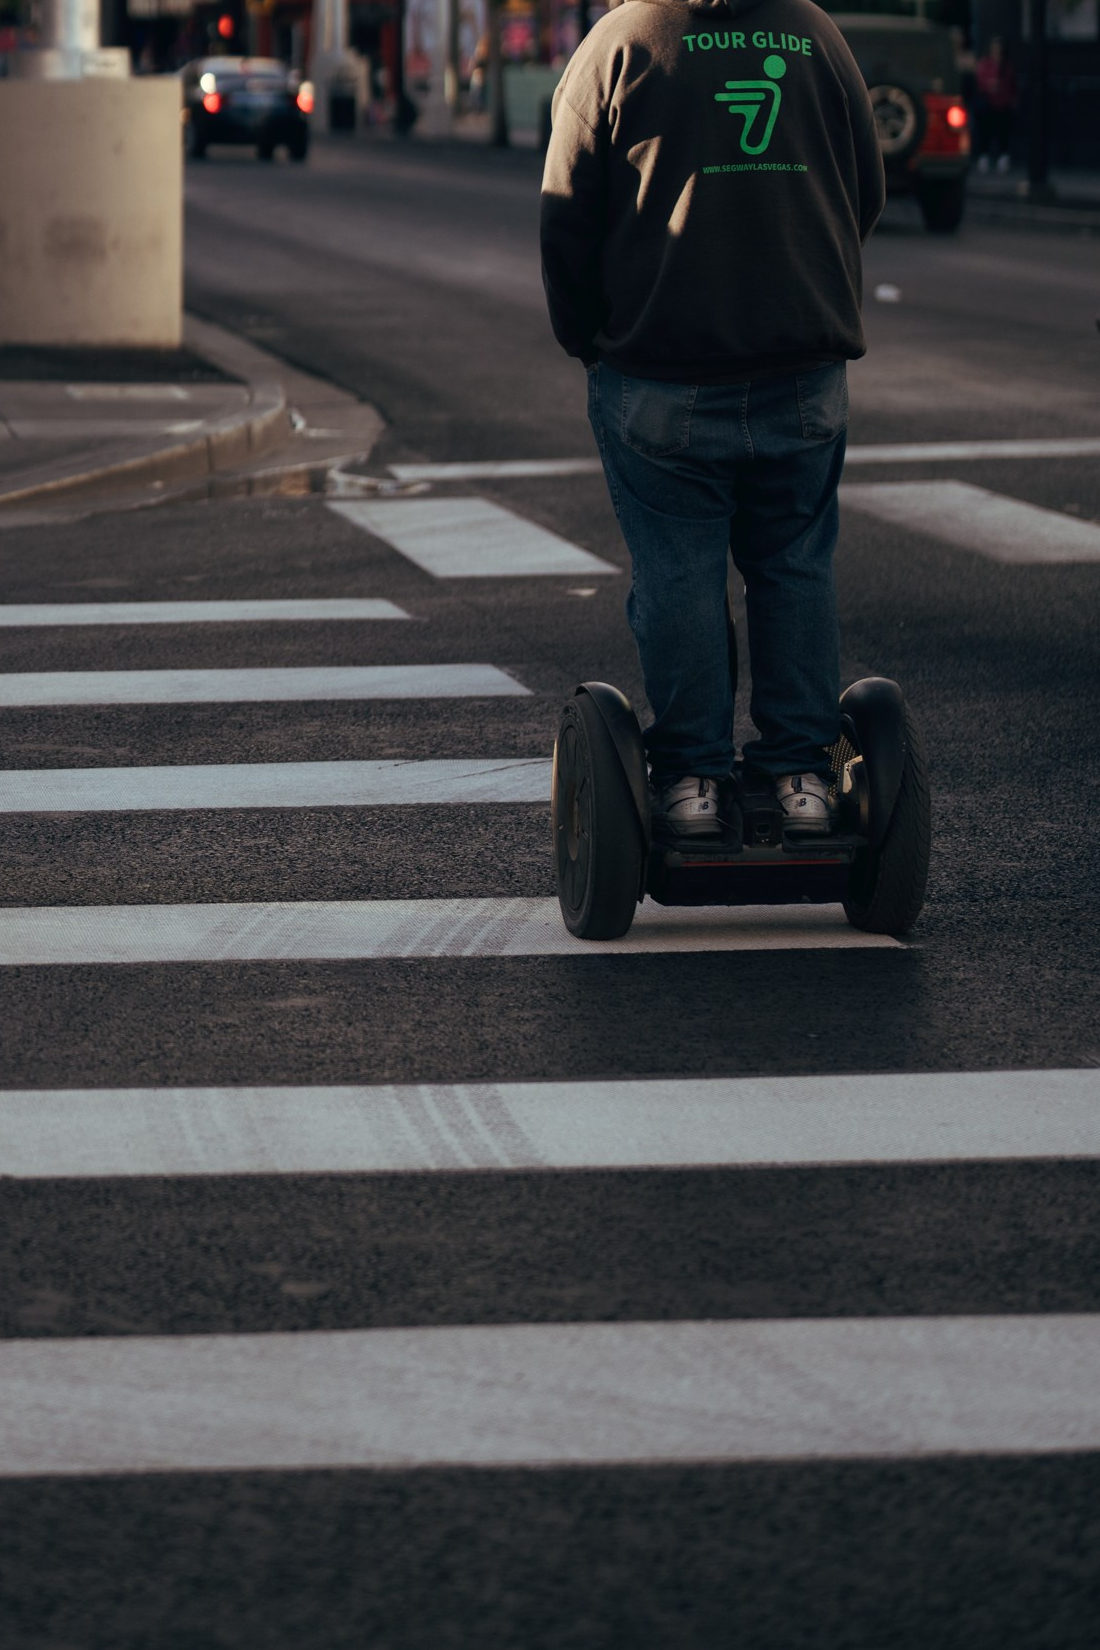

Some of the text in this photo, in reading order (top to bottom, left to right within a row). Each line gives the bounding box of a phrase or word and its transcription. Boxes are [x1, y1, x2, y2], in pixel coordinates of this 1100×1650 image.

[682, 31, 813, 57] TOUR GLIDE
[702, 163, 808, 174] WWW.SEGWAYLASVEGAS.COM
